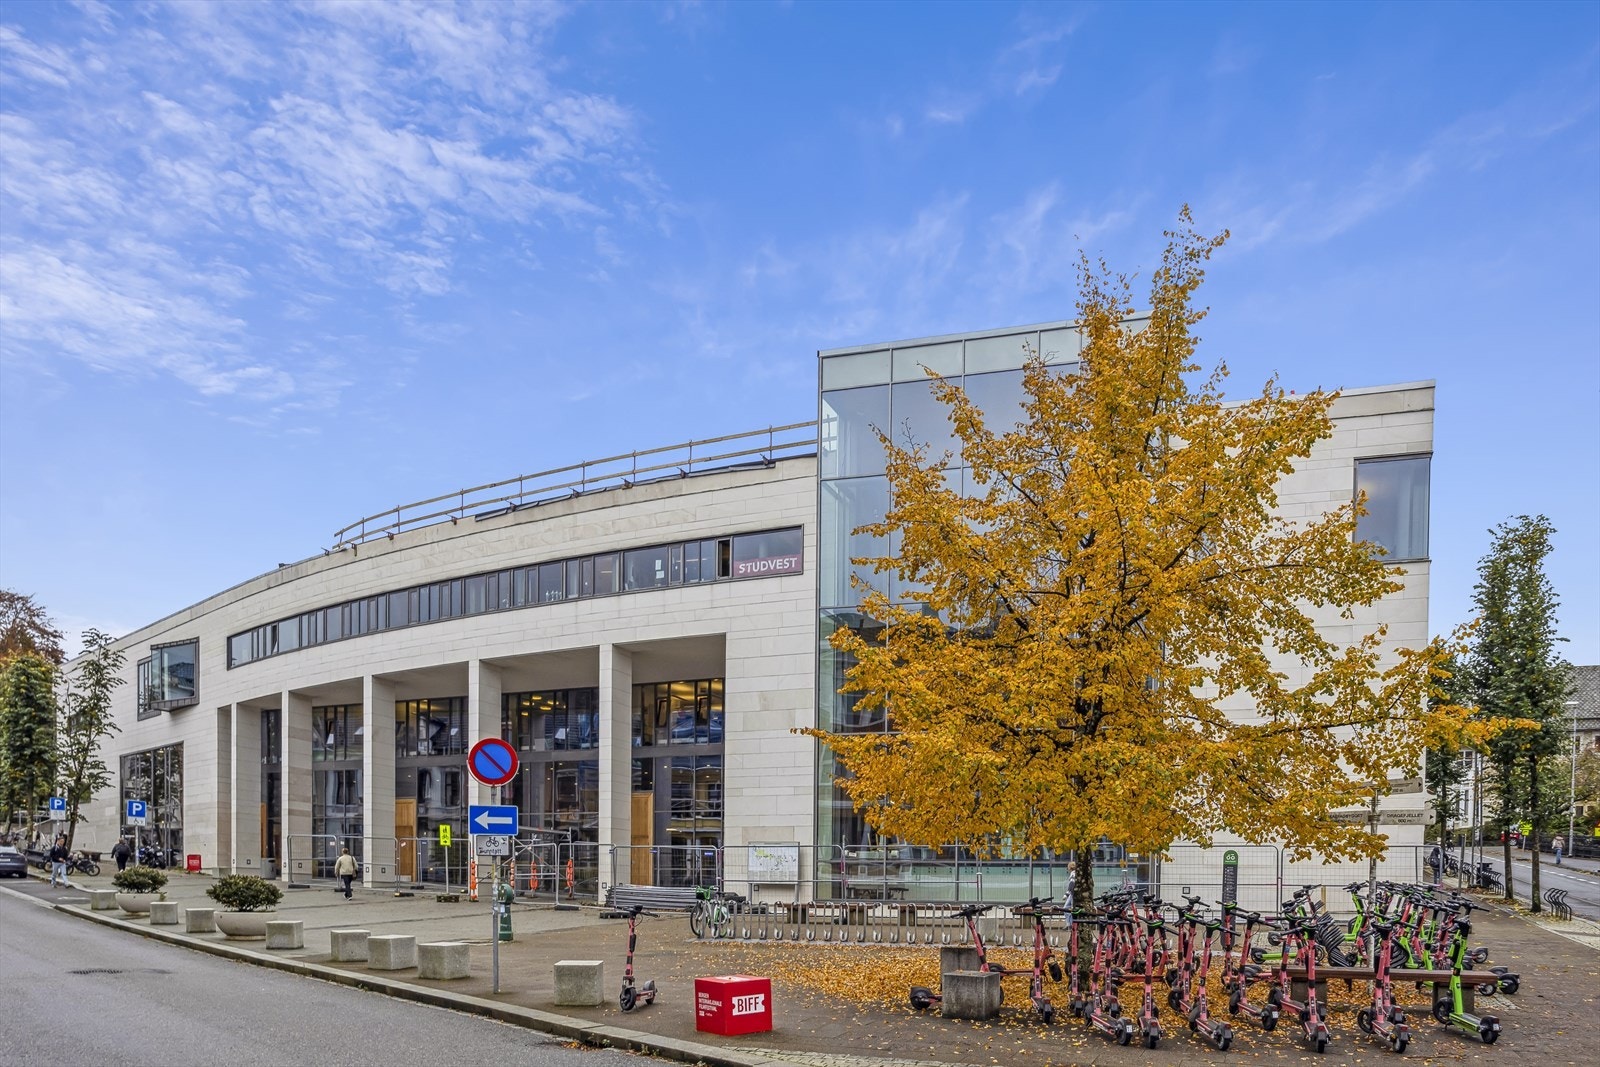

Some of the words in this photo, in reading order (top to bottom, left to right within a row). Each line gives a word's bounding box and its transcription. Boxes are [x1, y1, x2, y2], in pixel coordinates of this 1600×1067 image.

[739, 557, 798, 573] STUDVEST
[54, 800, 63, 809] P
[132, 803, 143, 816] P
[737, 996, 760, 1013] BIFF
